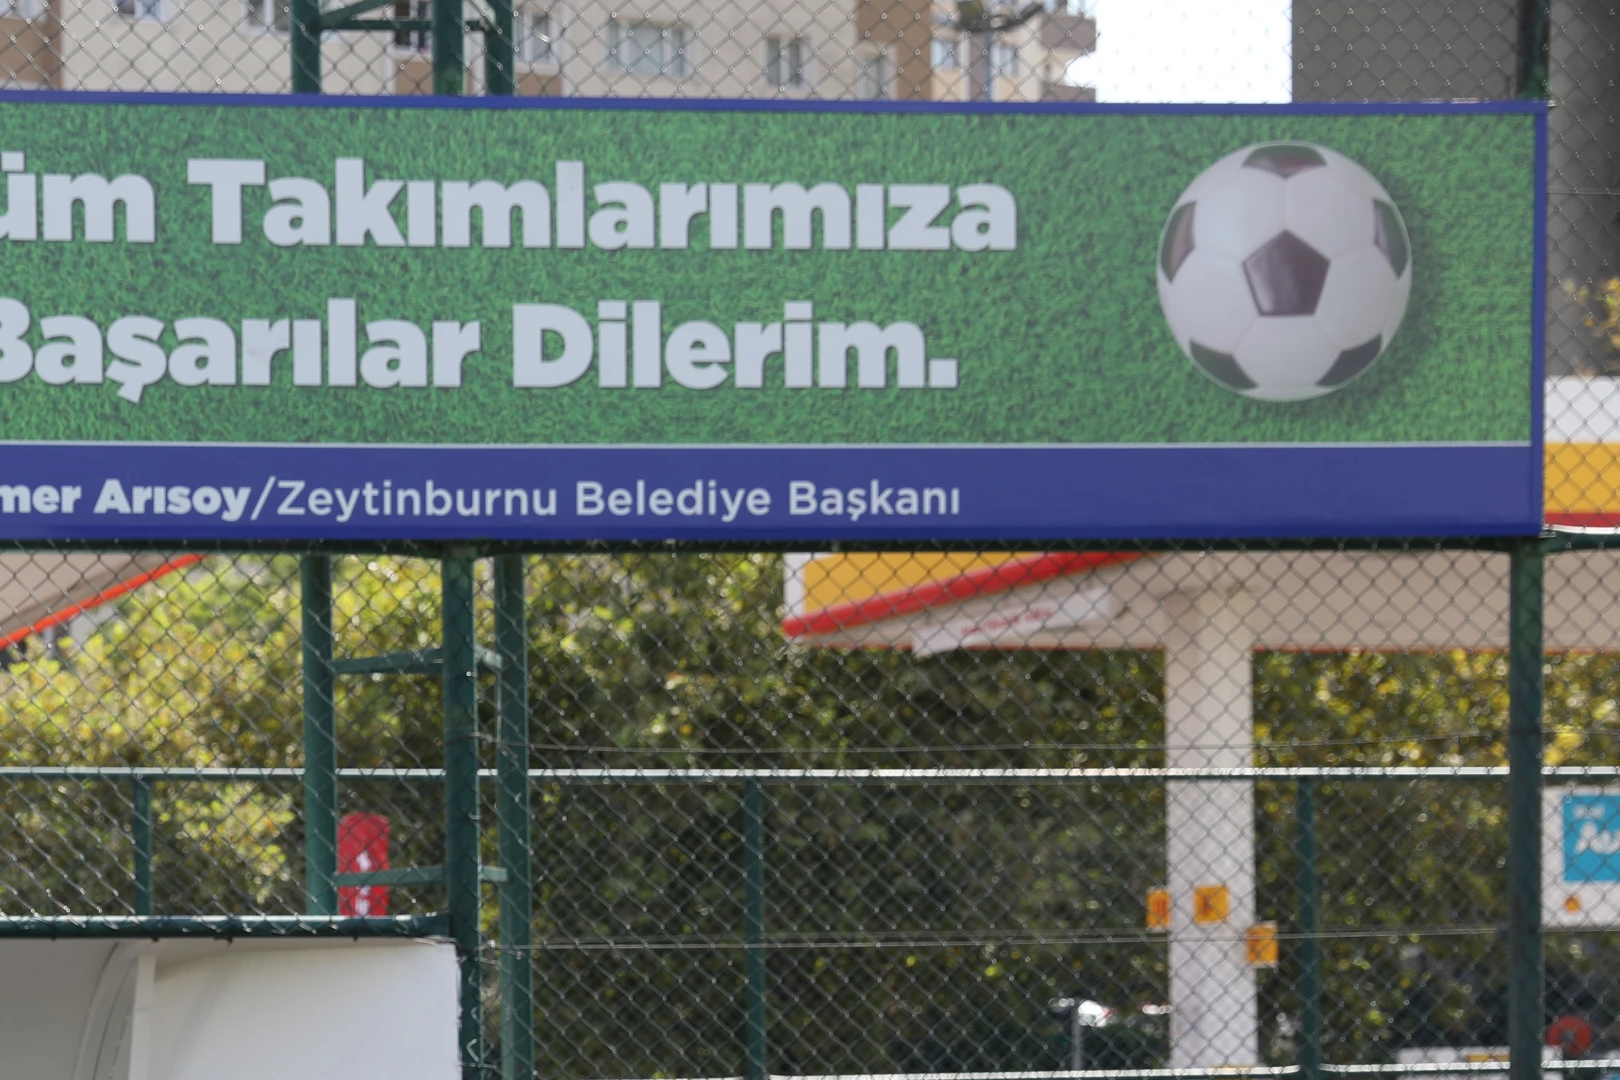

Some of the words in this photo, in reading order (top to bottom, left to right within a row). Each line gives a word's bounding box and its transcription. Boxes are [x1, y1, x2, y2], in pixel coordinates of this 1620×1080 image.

[187, 157, 1019, 252] Takımlarımıza
[512, 300, 960, 390] Dilerim.
[577, 479, 773, 523] Belediye
[789, 479, 961, 523] Başkanı
